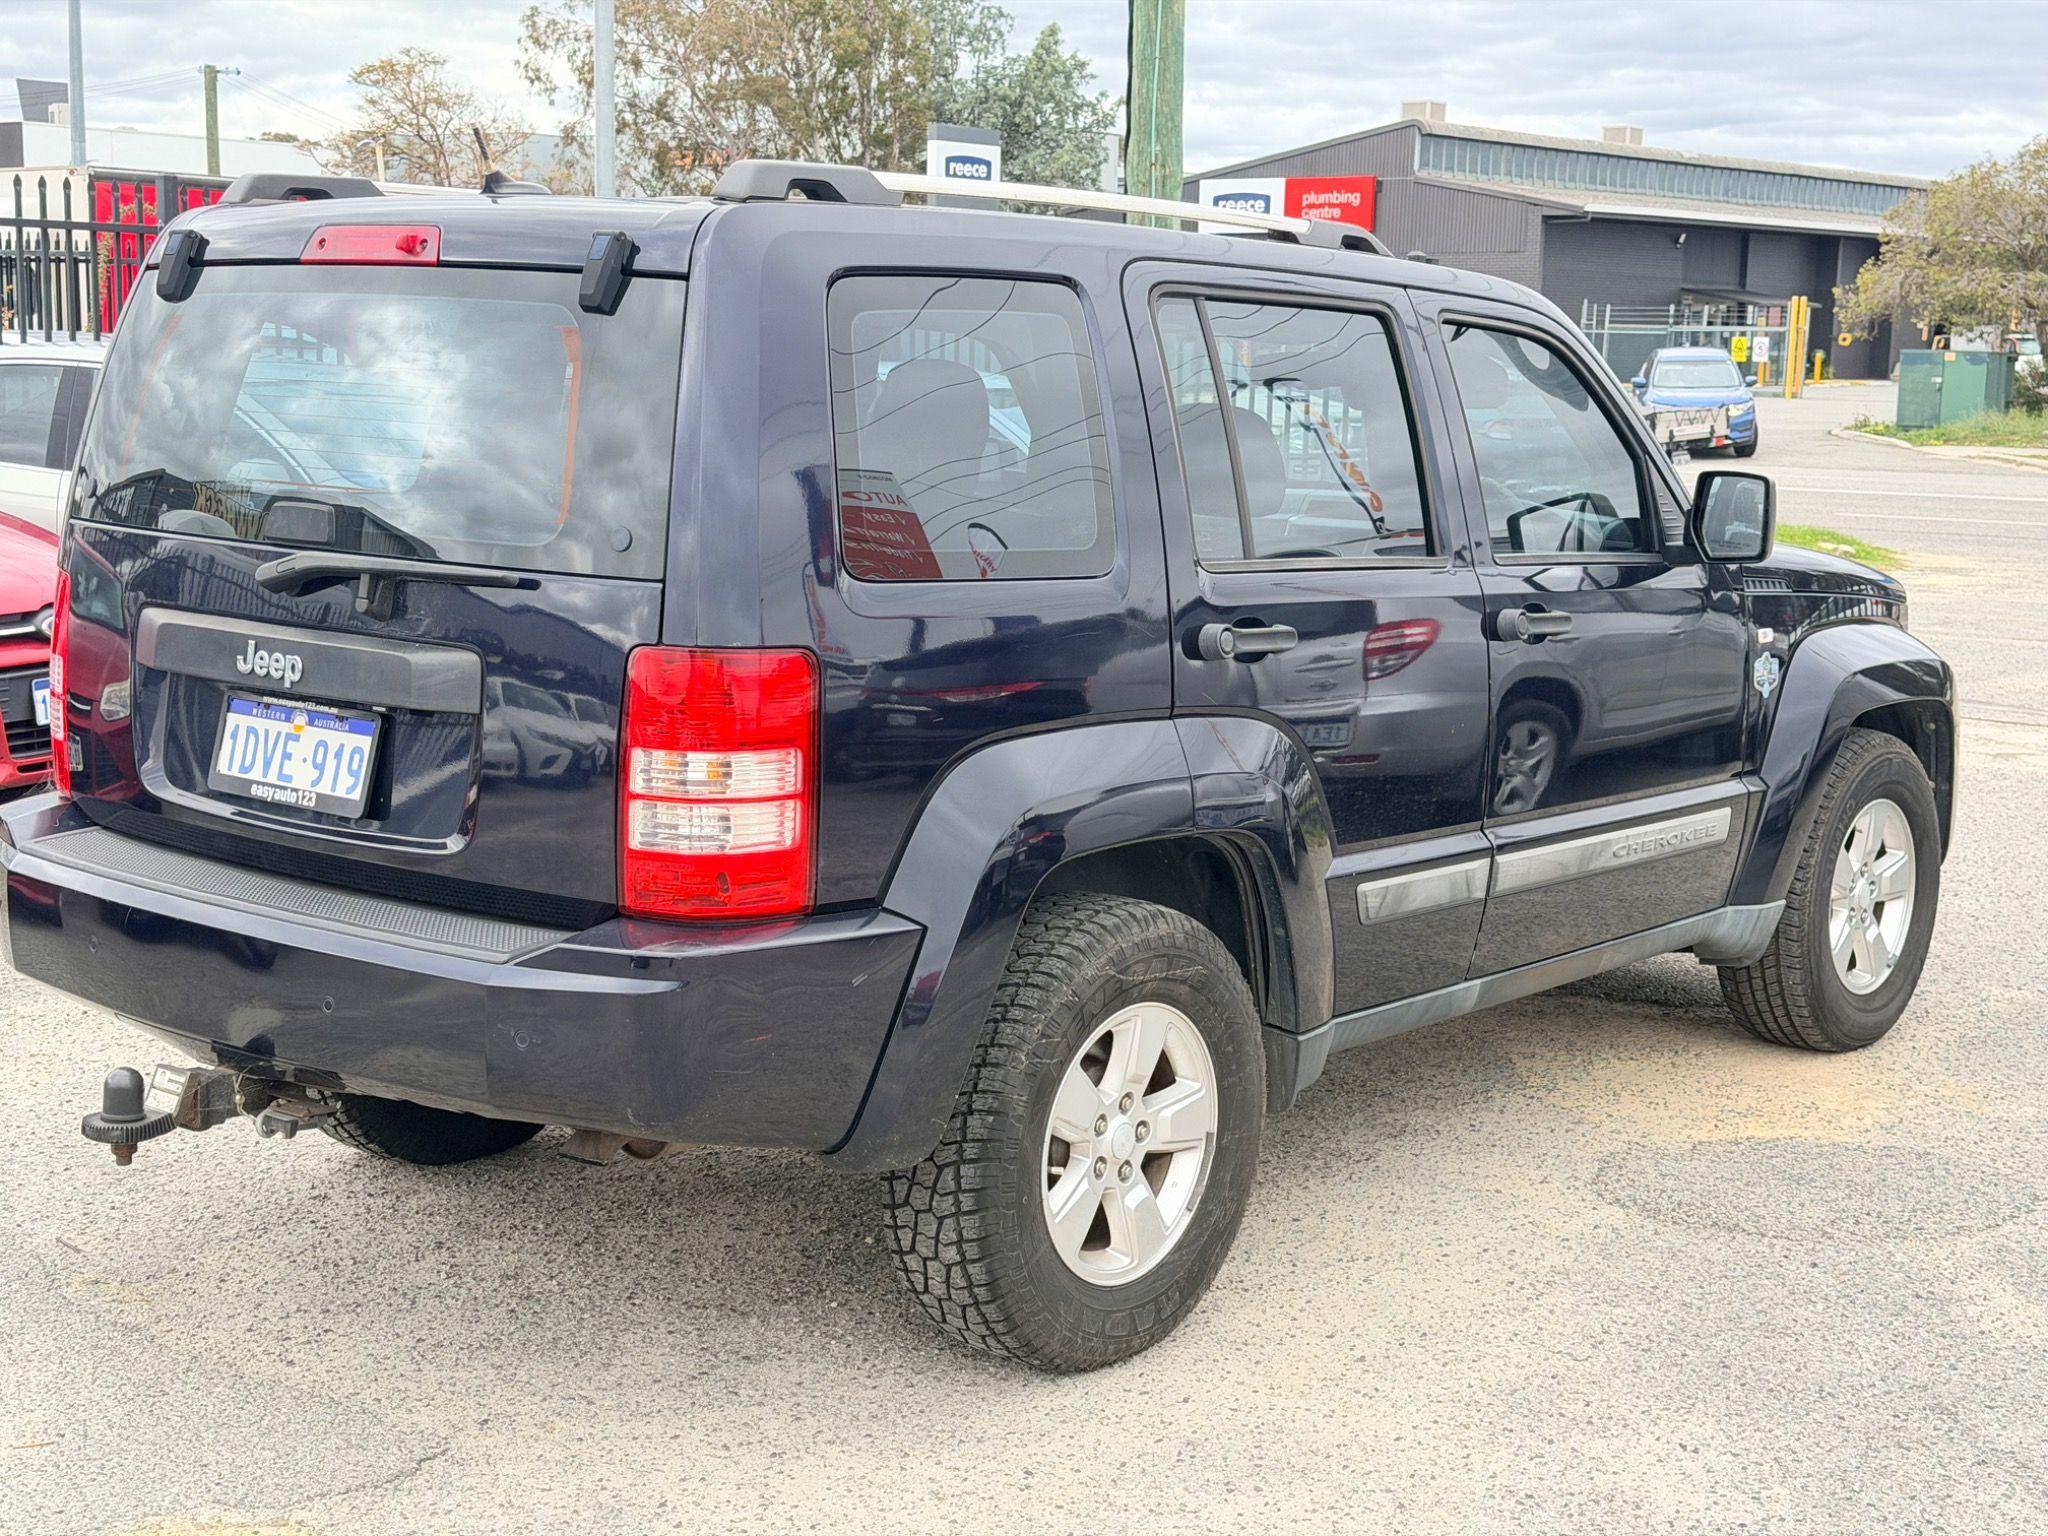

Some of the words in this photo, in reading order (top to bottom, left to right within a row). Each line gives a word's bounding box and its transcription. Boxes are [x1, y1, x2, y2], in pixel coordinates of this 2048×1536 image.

[949, 162, 988, 178] reece
[1301, 190, 1361, 209] plumbing
[1301, 206, 1341, 219] centre
[236, 640, 304, 688] Jeep
[252, 708, 286, 721] WESTERN
[313, 719, 350, 731] AUSTRALIA
[250, 783, 317, 807] easyauto123
[1612, 822, 1718, 858] CHEROKEE
